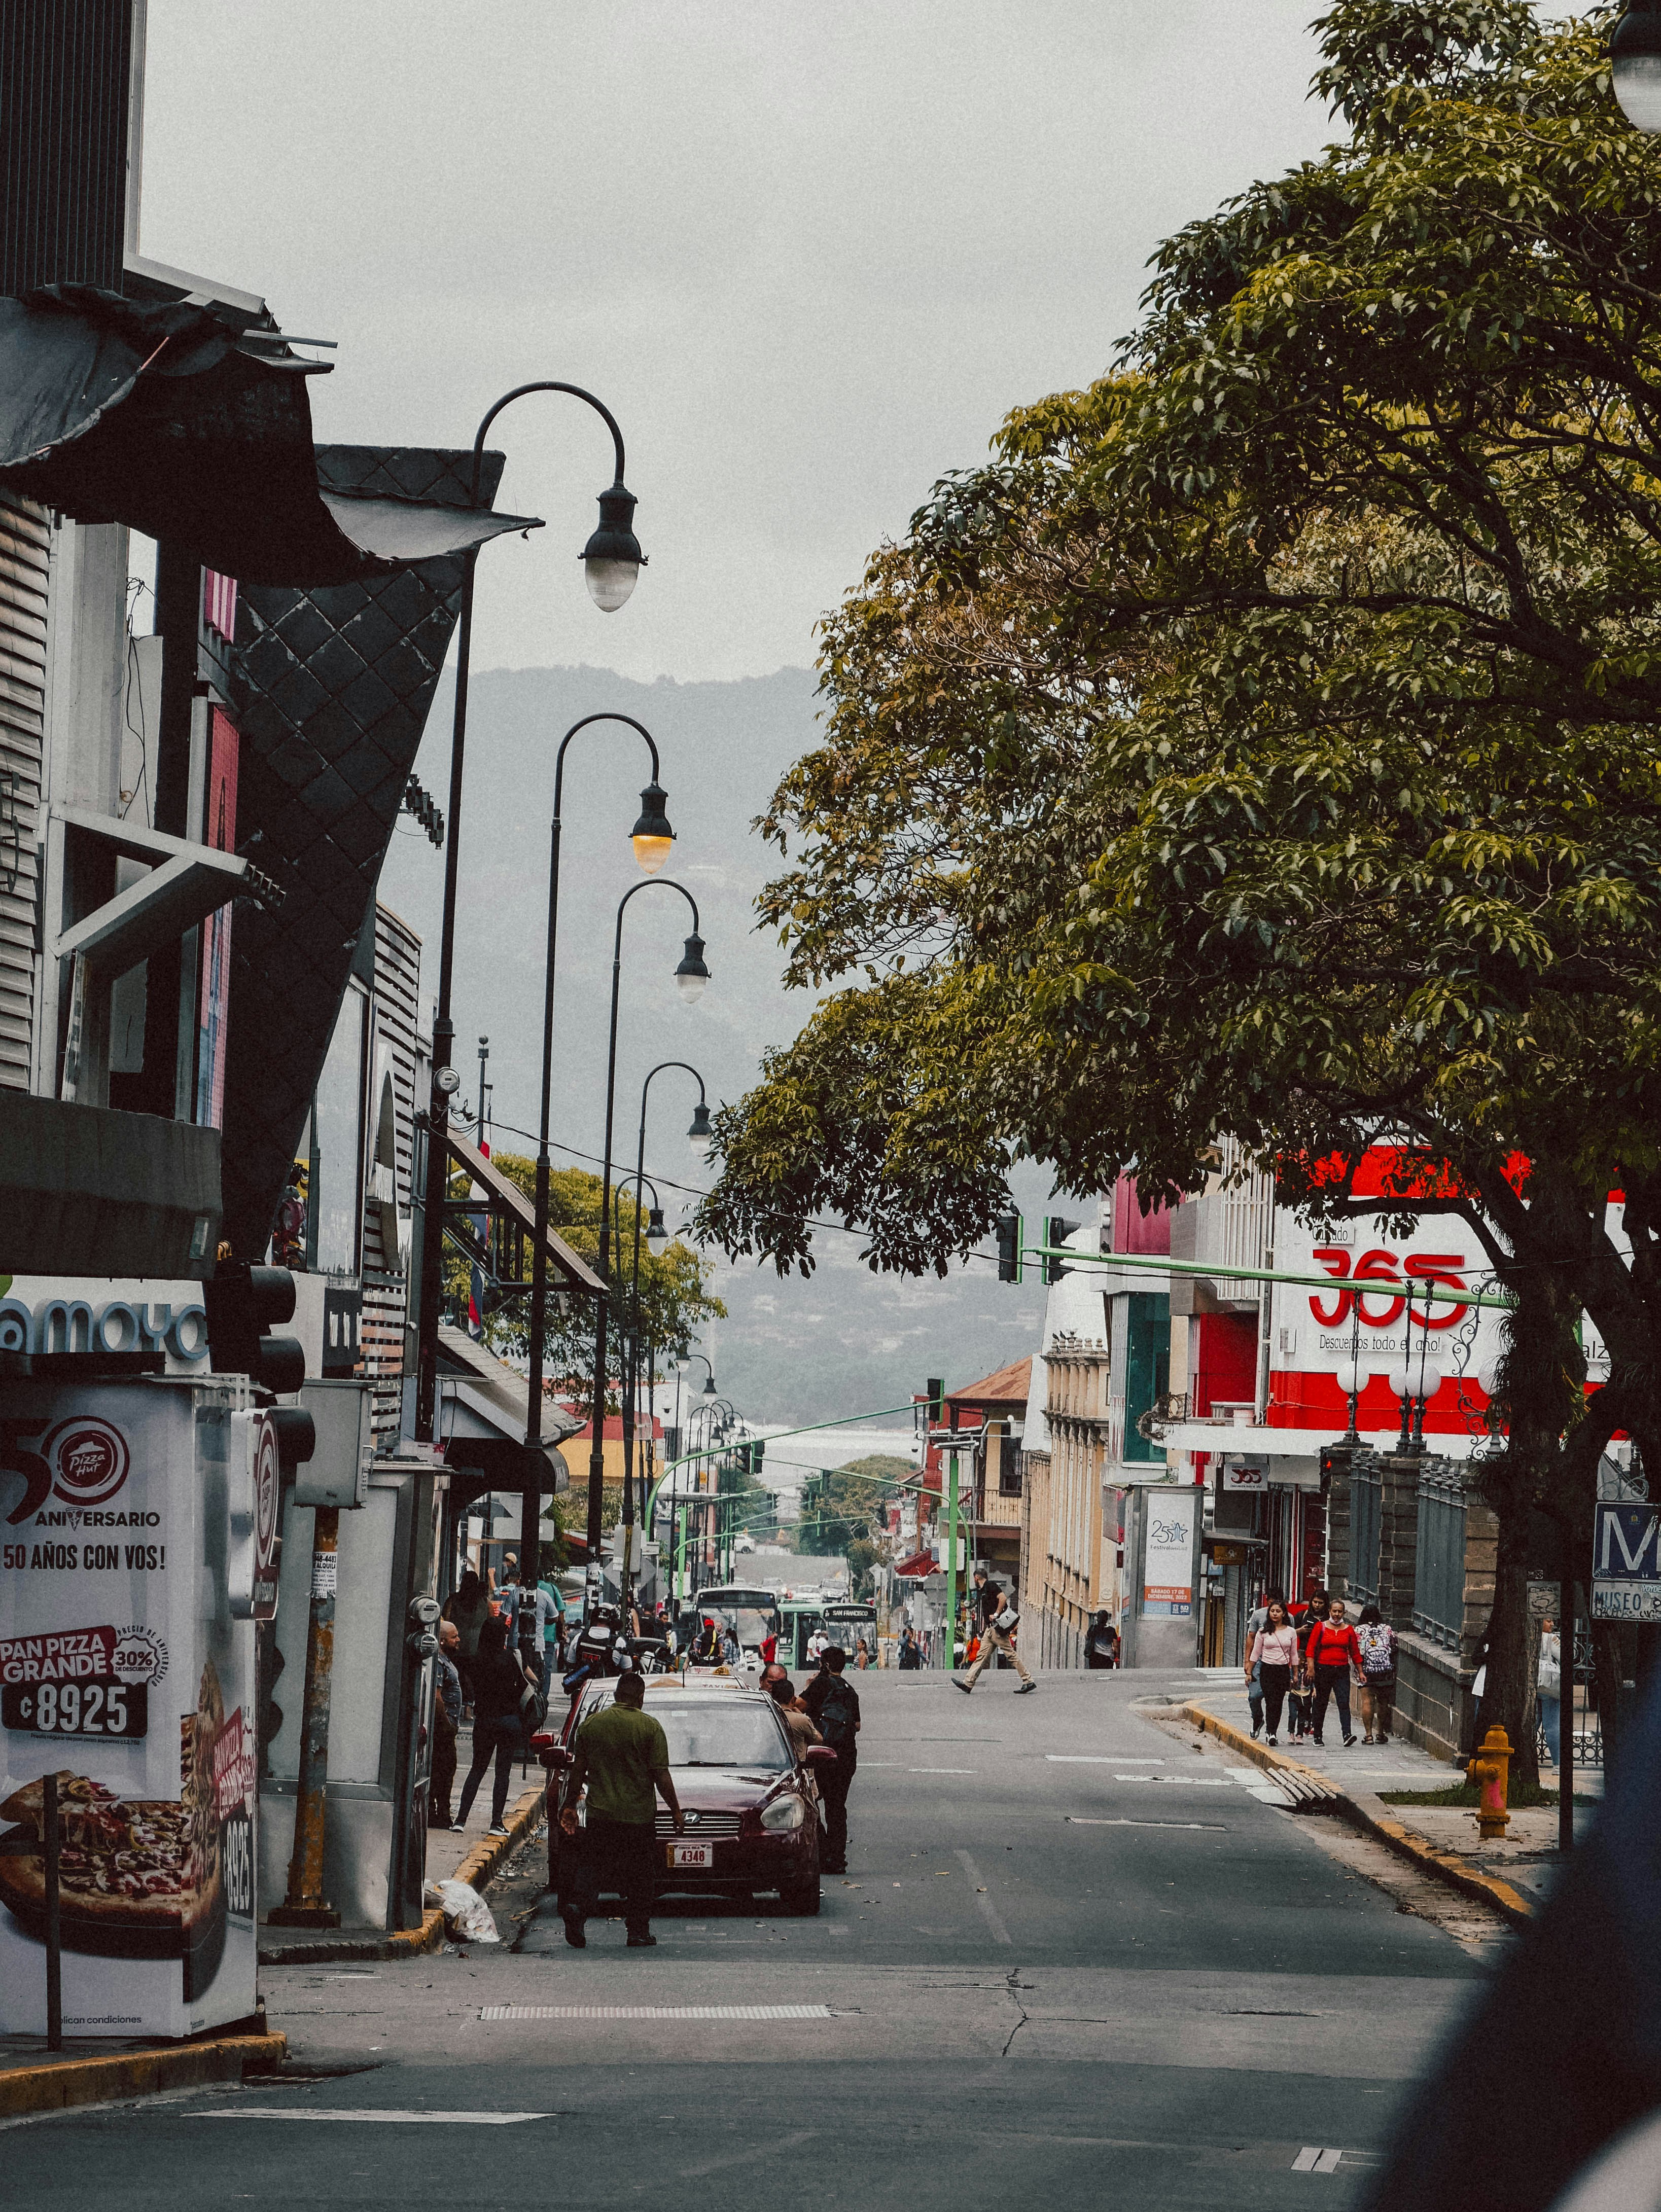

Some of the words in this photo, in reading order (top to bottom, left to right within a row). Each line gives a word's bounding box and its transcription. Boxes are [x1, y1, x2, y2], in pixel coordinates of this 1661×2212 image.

[1313, 1225, 1348, 1241] Caado
[1309, 1249, 1469, 1329] 365
[1320, 1335, 1368, 1349] Descuenos
[1372, 1336, 1395, 1350] todo
[69, 1454, 105, 1471] Pizza
[76, 1462, 101, 1477] Hut
[1151, 1520, 1170, 1543] 25
[4, 1544, 26, 1569] 50
[30, 1541, 77, 1569] AÑOS
[84, 1544, 119, 1570] CON
[125, 1545, 165, 1570] VOS!
[1595, 1591, 1641, 1611] MUSEO
[117, 1625, 144, 1636] PRECIO
[147, 1629, 156, 1638] DE
[1, 1639, 43, 1661] PAN
[46, 1634, 105, 1657] PIZZA
[115, 1651, 153, 1666] 30%
[3, 1653, 107, 1683] GRANDE
[681, 1850, 704, 1862] 4348
[61, 2015, 85, 2024] lican
[87, 2015, 142, 2024] condiciones
